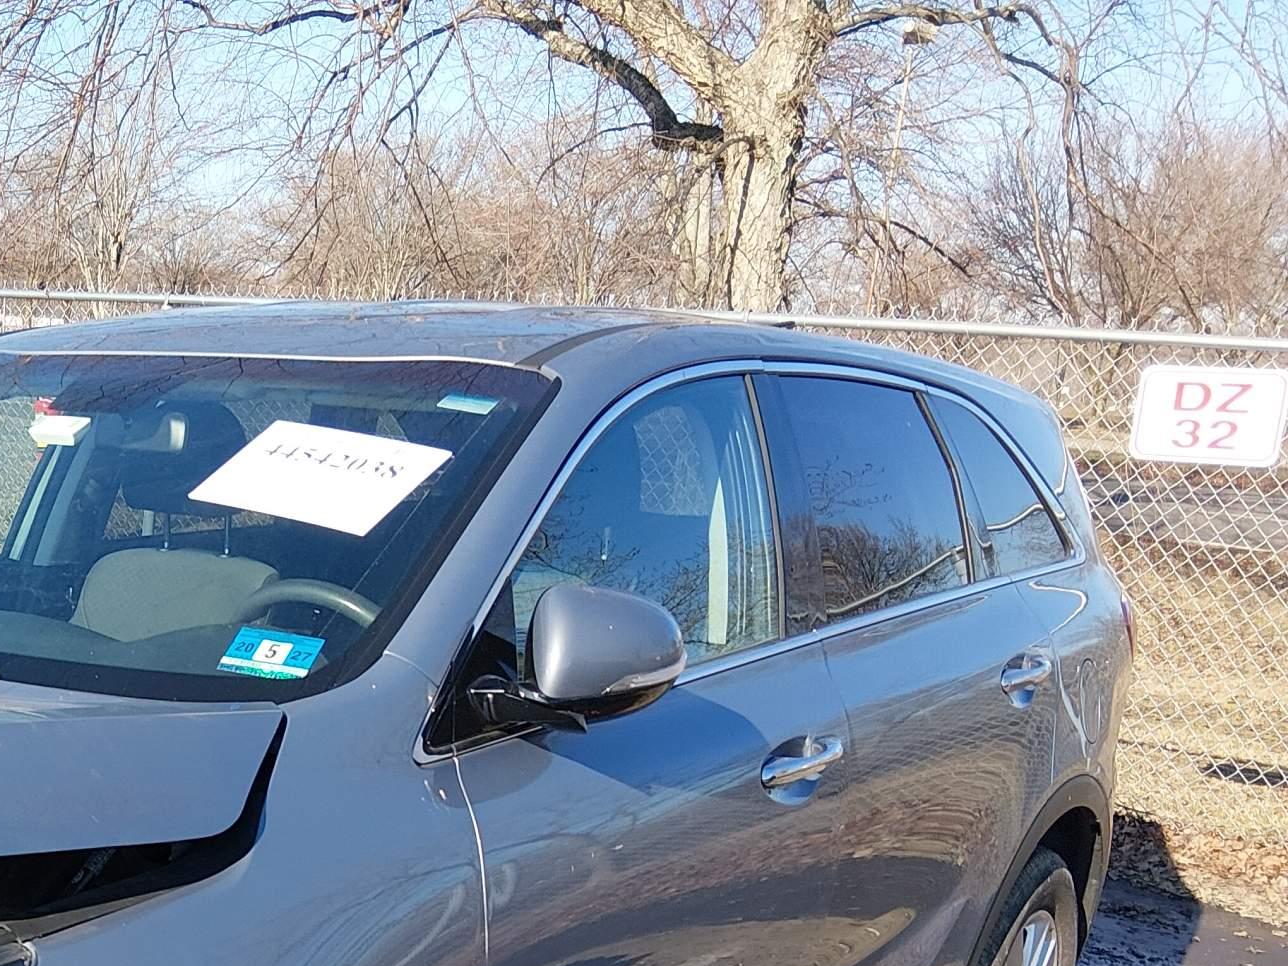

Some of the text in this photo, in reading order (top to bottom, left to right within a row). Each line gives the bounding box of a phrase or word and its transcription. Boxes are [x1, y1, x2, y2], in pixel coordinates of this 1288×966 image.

[1173, 381, 1253, 414] DZ
[1171, 419, 1239, 450] 32
[234, 640, 313, 663] 20 5 27
